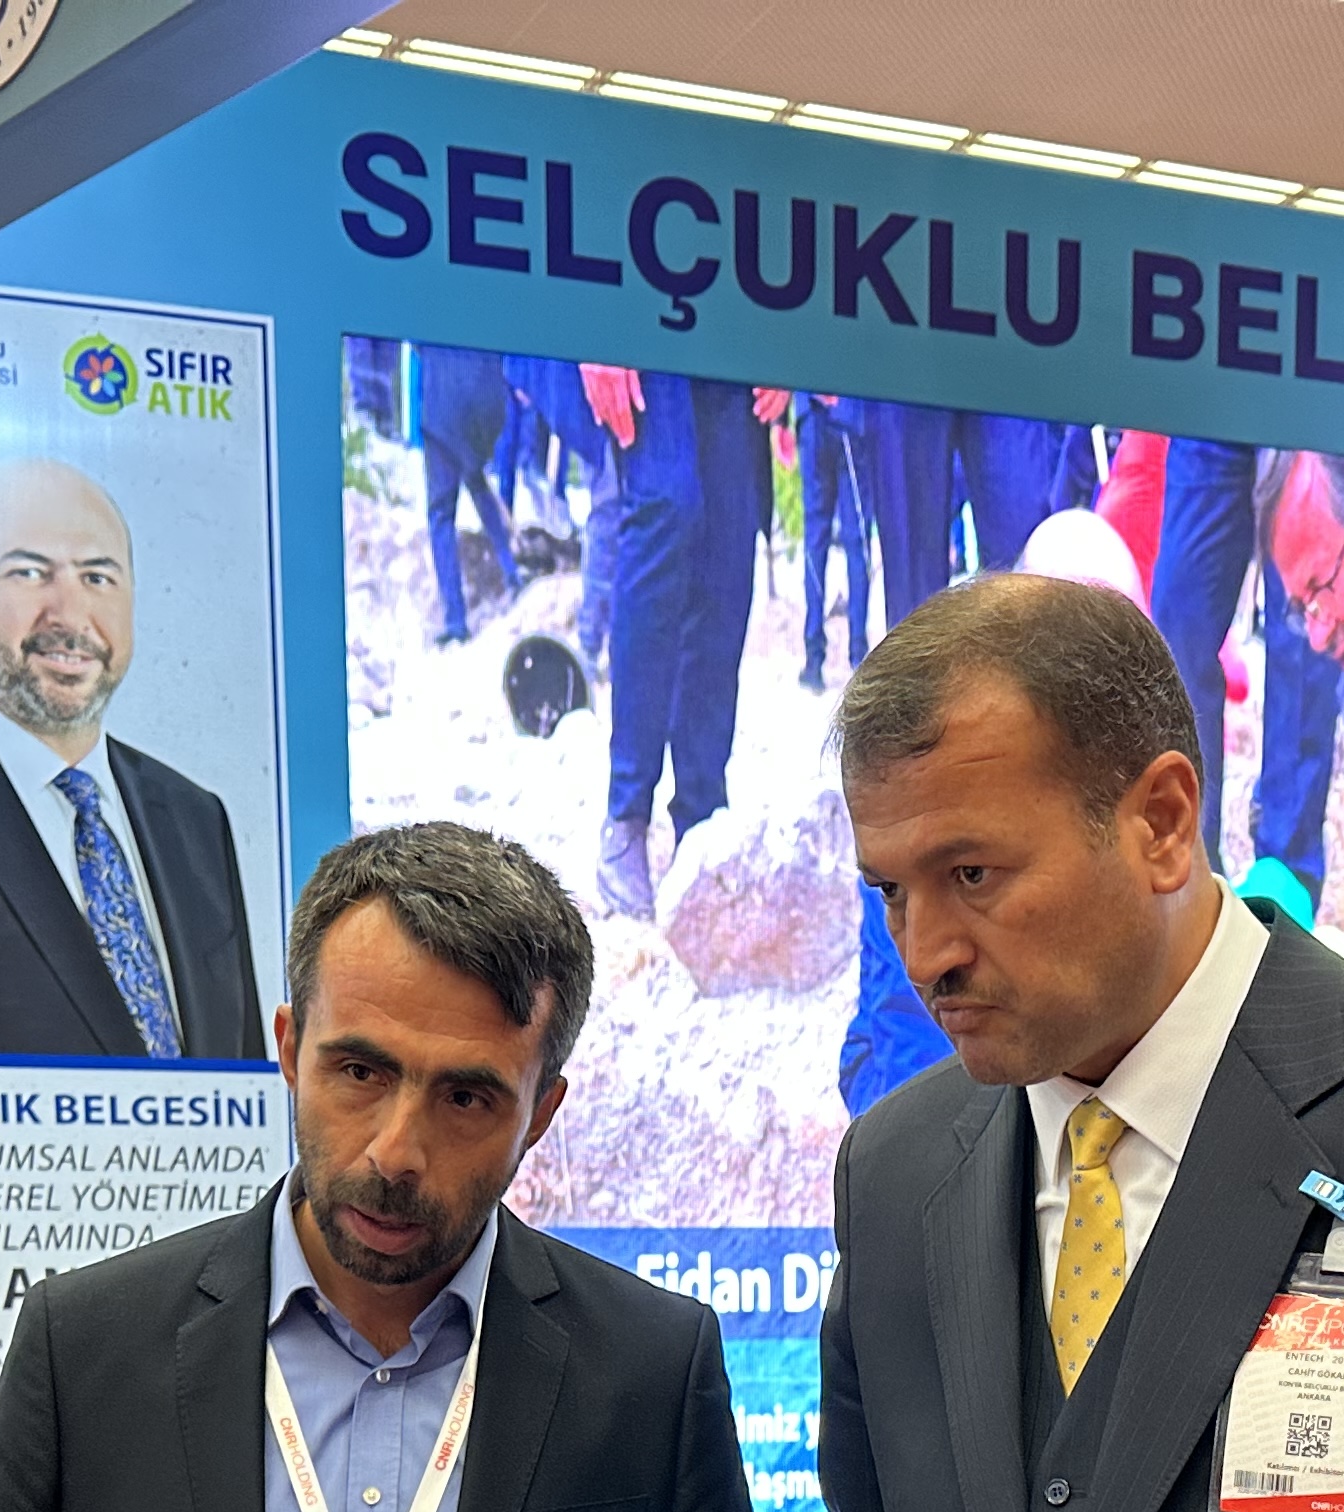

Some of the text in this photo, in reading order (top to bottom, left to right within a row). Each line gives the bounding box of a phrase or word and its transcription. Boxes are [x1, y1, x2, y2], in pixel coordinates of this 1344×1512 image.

[340, 130, 1081, 348] SELÇUKLU
[145, 347, 233, 385] SIFIR
[147, 382, 233, 422] ATIK
[55, 1089, 267, 1128] BELGESİNİ
[104, 1145, 267, 1173] ANLAMDA
[1285, 1351, 1324, 1363] ENTECH
[743, 1462, 822, 1510] laşm
